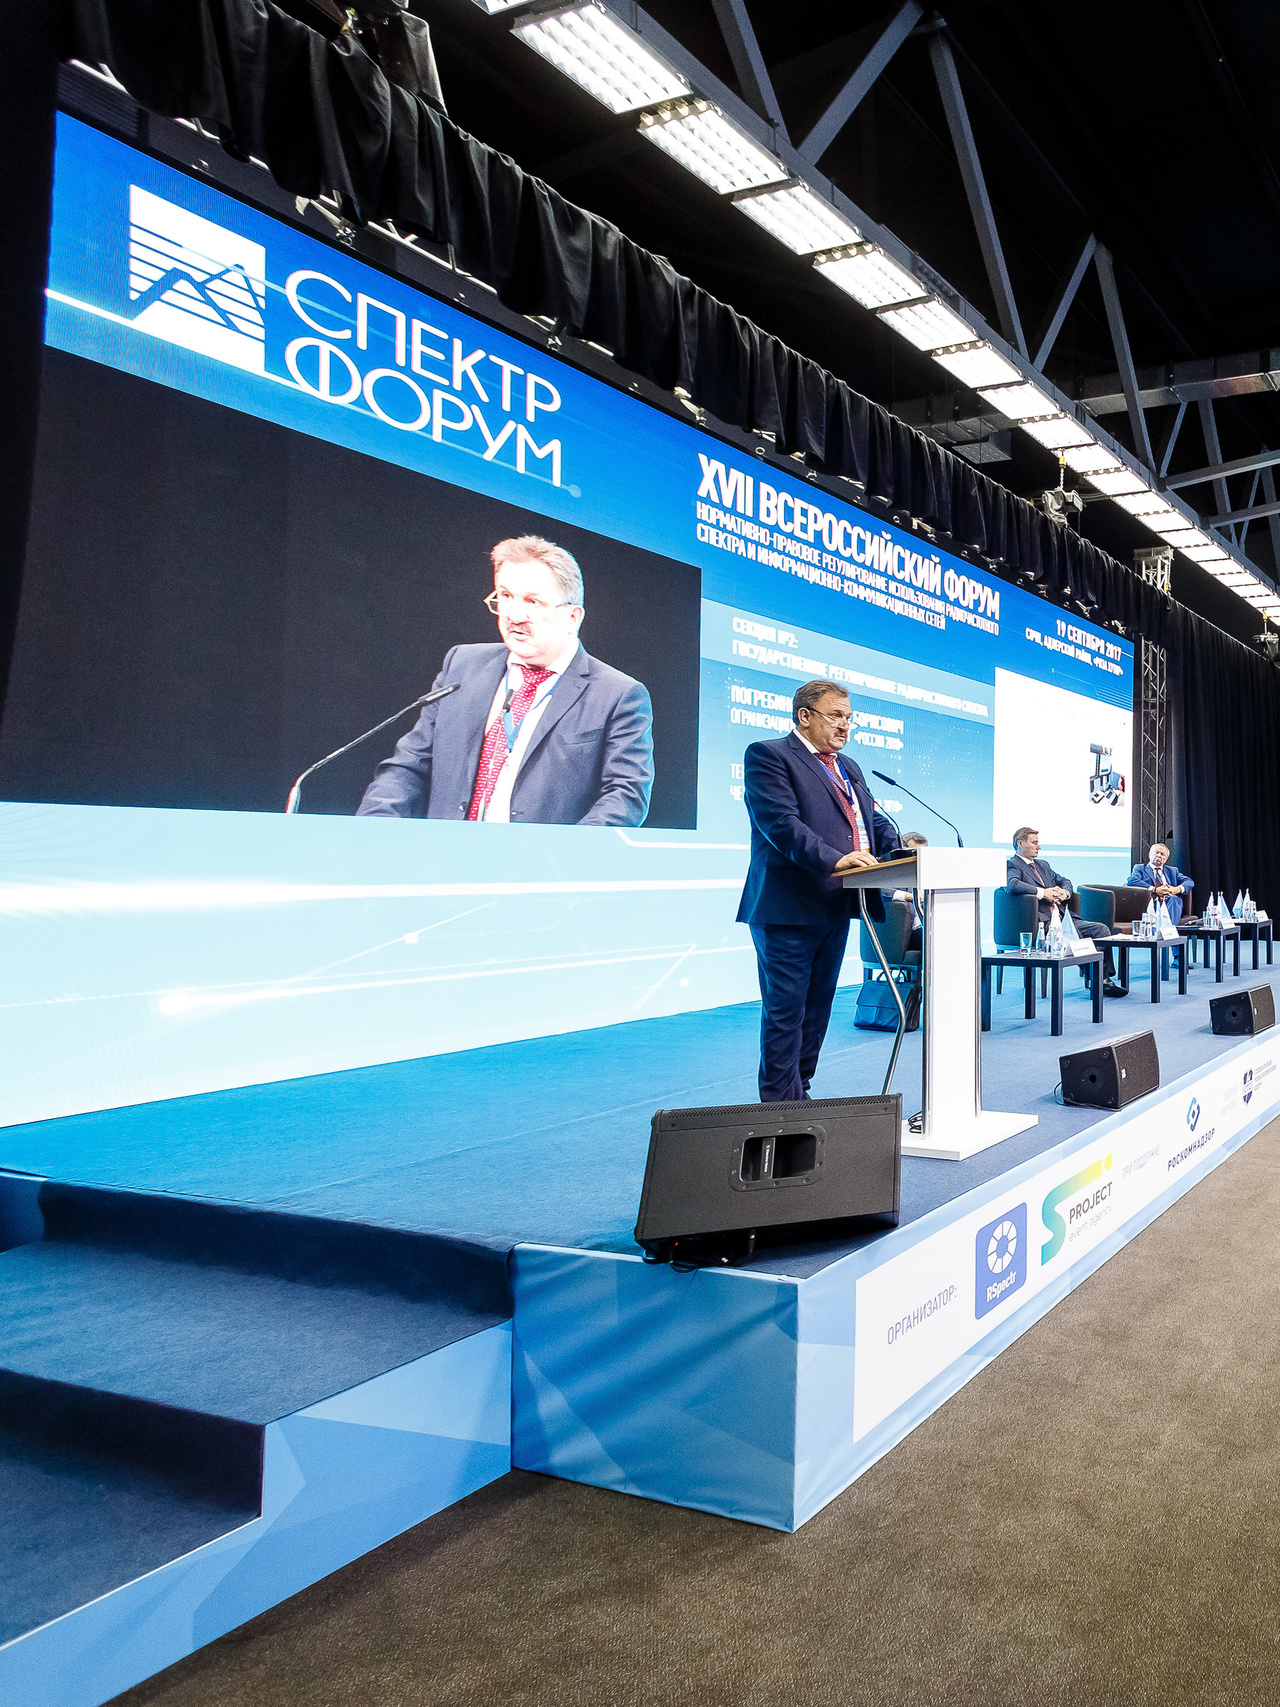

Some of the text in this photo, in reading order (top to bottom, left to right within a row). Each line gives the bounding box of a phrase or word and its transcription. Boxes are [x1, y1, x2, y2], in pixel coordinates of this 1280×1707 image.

[285, 270, 562, 423] СПЕКТР
[284, 336, 562, 487] ФОРУМ
[696, 452, 1000, 621] XVII ВСЕРОССИЙСКИЙ ФОРУМ
[696, 500, 822, 566] НОРМАТИВНО-ПРАВОВОЕ
[822, 552, 888, 592] РЕГУЛИРОВАНИЕ
[888, 578, 946, 615] ИСПОЛЬЗОВАНИЯ
[696, 522, 747, 557] СПЕКТРА
[747, 541, 756, 561] И
[925, 610, 946, 631] СЕТЕЙ
[732, 616, 777, 643] СЕКЦИЯ
[1056, 618, 1123, 662] 19 СЕНТЯБРЯ 2017
[732, 639, 828, 678] ГОСУДАРСТВЕННОЕ
[828, 663, 897, 695] РЕГУЛИРОВАНИЕ
[730, 707, 796, 734] ОГРАНИЗАЦИО
[731, 684, 794, 713] ПОГРЕБИН
[1167, 1127, 1216, 1172] РОСКОМНАДЗОР
[1068, 1204, 1113, 1242] event agency
[1069, 1181, 1113, 1224] PROJECT
[986, 1271, 1018, 1303] RSpectr
[887, 1284, 958, 1345] ОРГАНИЗАТОР:
